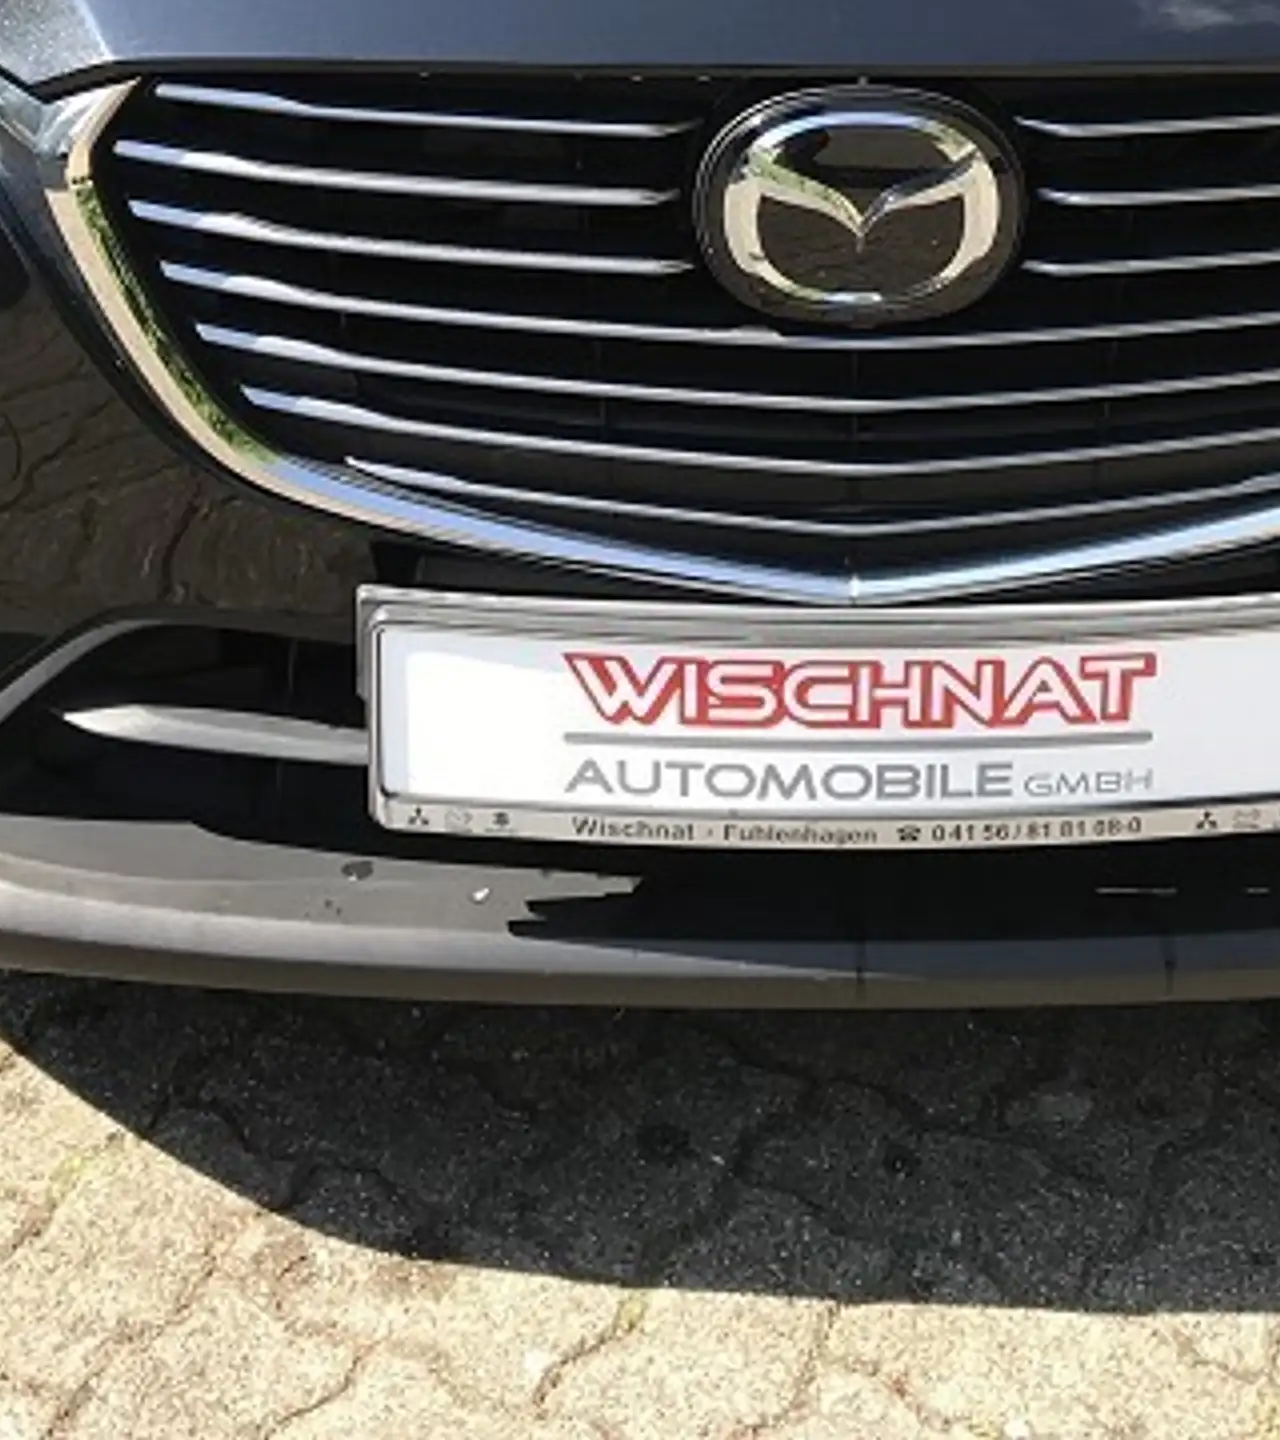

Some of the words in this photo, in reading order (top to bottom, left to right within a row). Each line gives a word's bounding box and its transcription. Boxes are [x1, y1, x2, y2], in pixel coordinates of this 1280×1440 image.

[563, 651, 1157, 728] WISCHNAT
[564, 758, 1014, 801] AUTOMOBILE
[1024, 768, 1153, 798] GMBH
[572, 815, 695, 841] Wischnat
[723, 823, 878, 846] Fuhlenhagen
